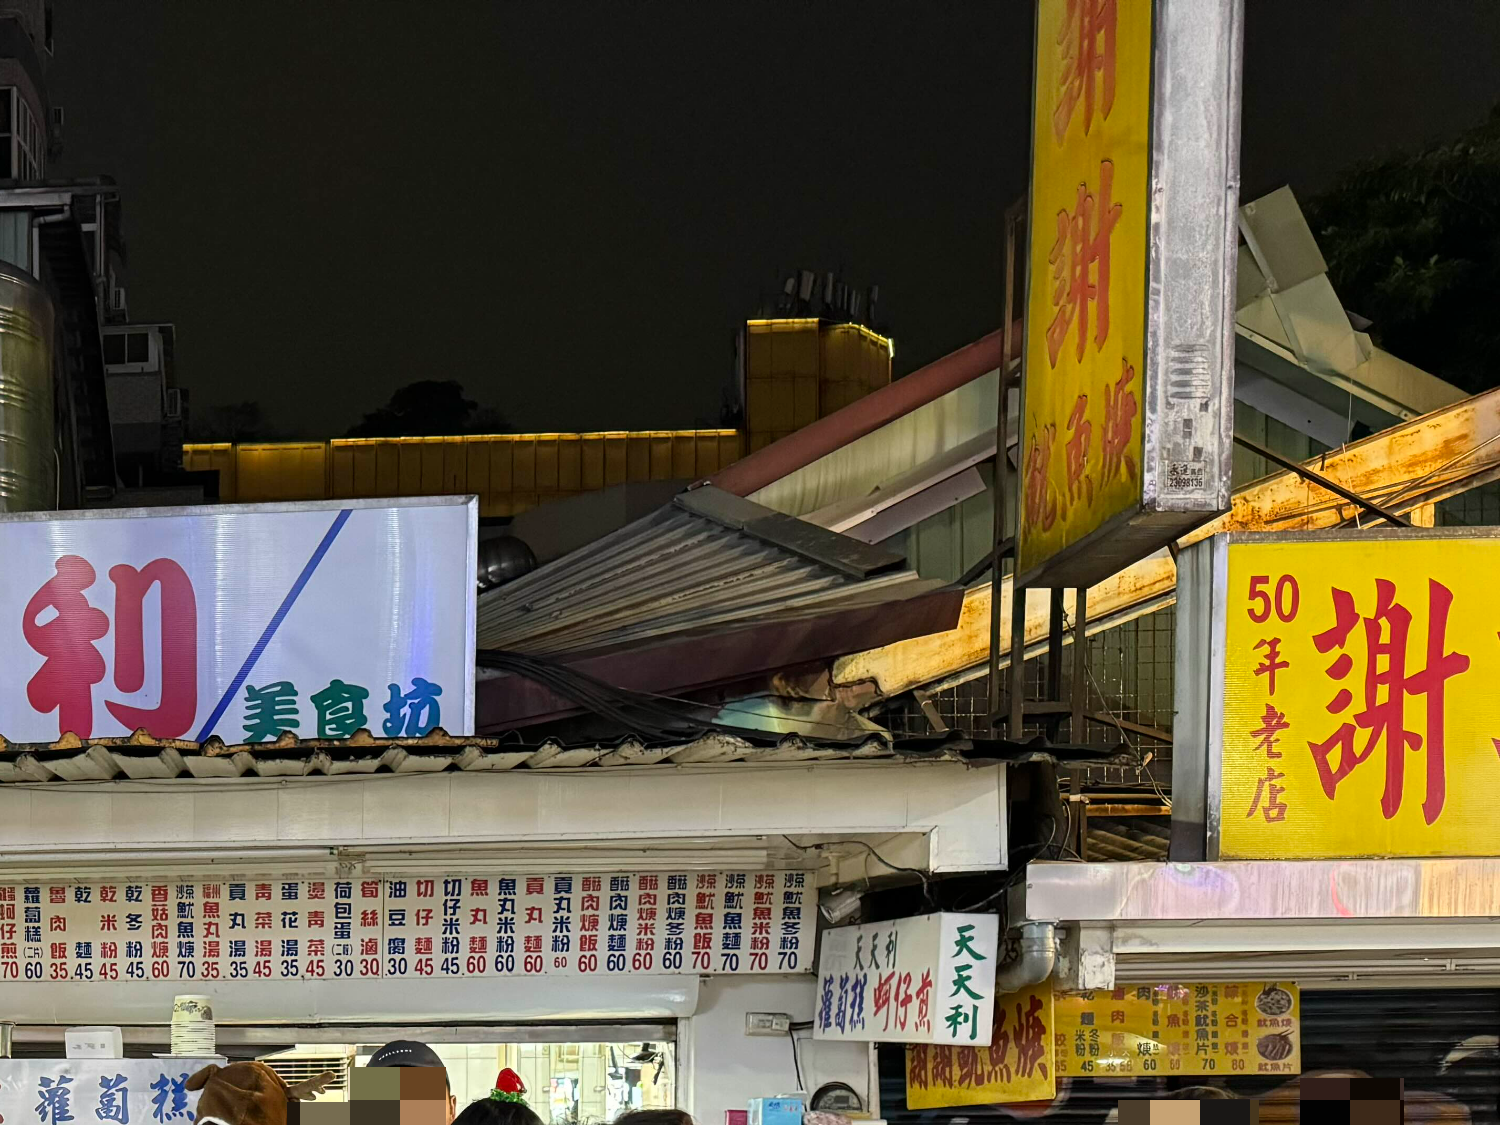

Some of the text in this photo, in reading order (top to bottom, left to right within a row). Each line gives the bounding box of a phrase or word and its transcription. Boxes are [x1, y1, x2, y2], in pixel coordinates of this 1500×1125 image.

[242, 677, 443, 745] 美食坊
[49, 887, 68, 980] 魯肉飯 35
[75, 887, 93, 980] 乾麵 45
[99, 886, 119, 980] 乾米粉 45
[125, 886, 145, 978] 乾冬粉 45
[201, 884, 220, 978] 福州魚丸湯 35
[228, 883, 248, 978] 貢丸湯 35
[253, 883, 272, 977] 青菜湯 45
[280, 882, 299, 976] 蛋花湯 35
[305, 882, 325, 977] 燙青菜 45
[388, 880, 408, 975] 油豆腐 30
[414, 879, 434, 975] 切仔麵 45
[440, 879, 462, 974] 切仔米粉 45
[466, 879, 489, 973] 魚丸麵 60
[494, 878, 516, 972] 魚丸米粉 60
[523, 877, 544, 973] 貢丸麵 60
[551, 876, 573, 968] 貢丸米粉 60
[1, 961, 19, 979] 70
[25, 961, 43, 979] 60
[152, 961, 170, 978] 60
[177, 961, 196, 978] 70
[333, 959, 354, 977] 30
[359, 958, 379, 976] 30
[578, 954, 598, 972] 60
[606, 953, 626, 972] 60
[632, 952, 652, 970] 60
[662, 951, 682, 969] 60
[692, 951, 711, 969] 70
[721, 953, 739, 971] 70
[749, 953, 768, 970] 70
[778, 951, 797, 969] 70
[853, 930, 898, 972] 天天利
[873, 967, 933, 1034] 蚵仔煎
[945, 924, 987, 1041] 天天利
[1080, 1060, 1094, 1072] 45
[1143, 1059, 1157, 1071] 60
[1202, 1058, 1216, 1071] 70
[1231, 1058, 1245, 1071] 80
